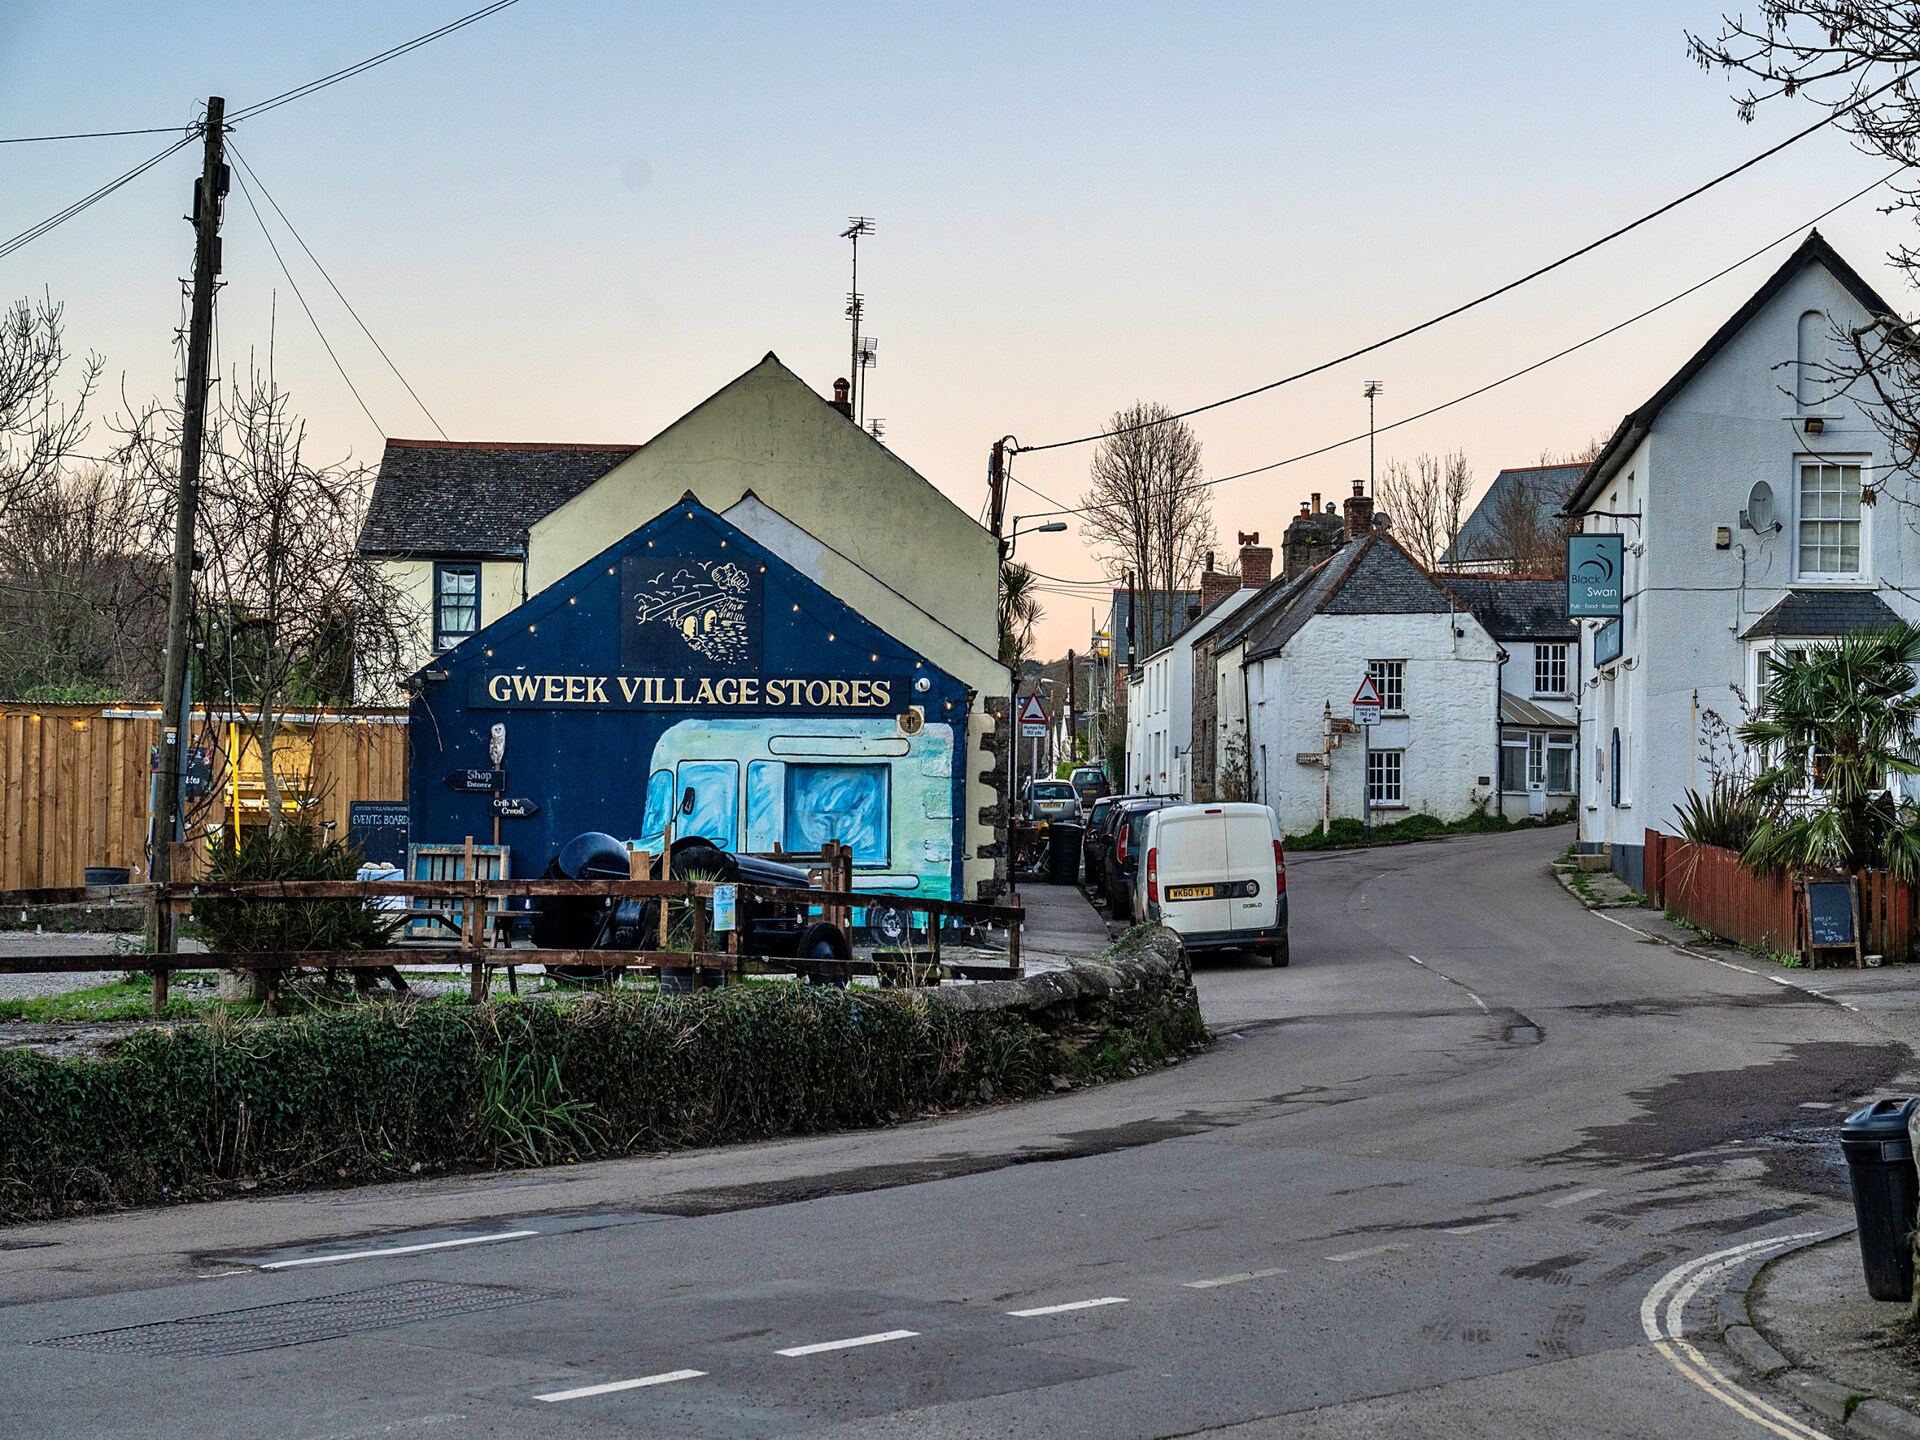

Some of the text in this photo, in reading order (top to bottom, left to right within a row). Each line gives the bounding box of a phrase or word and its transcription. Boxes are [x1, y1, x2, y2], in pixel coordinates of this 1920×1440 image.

[1571, 574, 1601, 584] Black
[1587, 586, 1617, 597] Swan
[488, 674, 891, 708] GWEEK VILLAGE STORES
[467, 770, 492, 781] Shop
[493, 799, 510, 807] Crib
[352, 814, 409, 825] EVENTS BOARD
